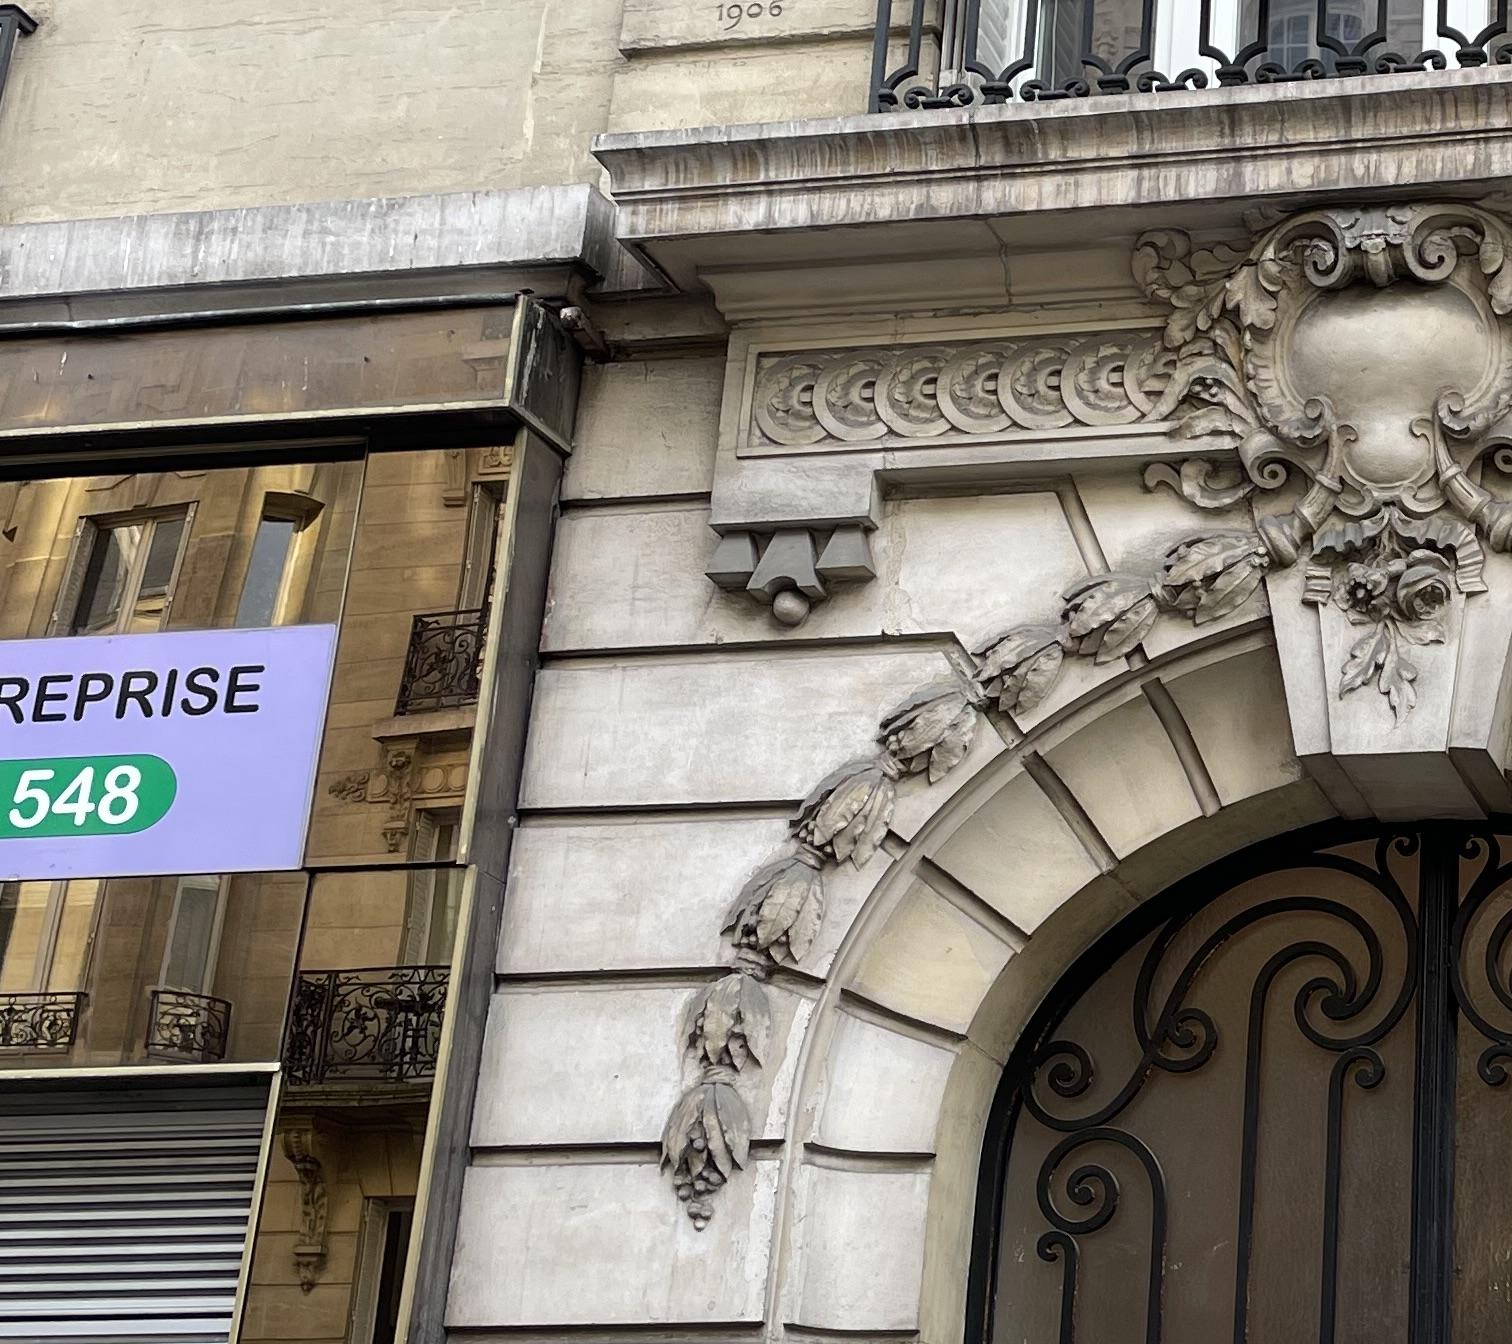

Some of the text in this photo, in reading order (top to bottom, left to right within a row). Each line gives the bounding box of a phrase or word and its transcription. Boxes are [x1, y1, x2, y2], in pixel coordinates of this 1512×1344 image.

[716, 0, 784, 31] 1906
[0, 665, 265, 724] REPRISE
[9, 765, 142, 829] 548
